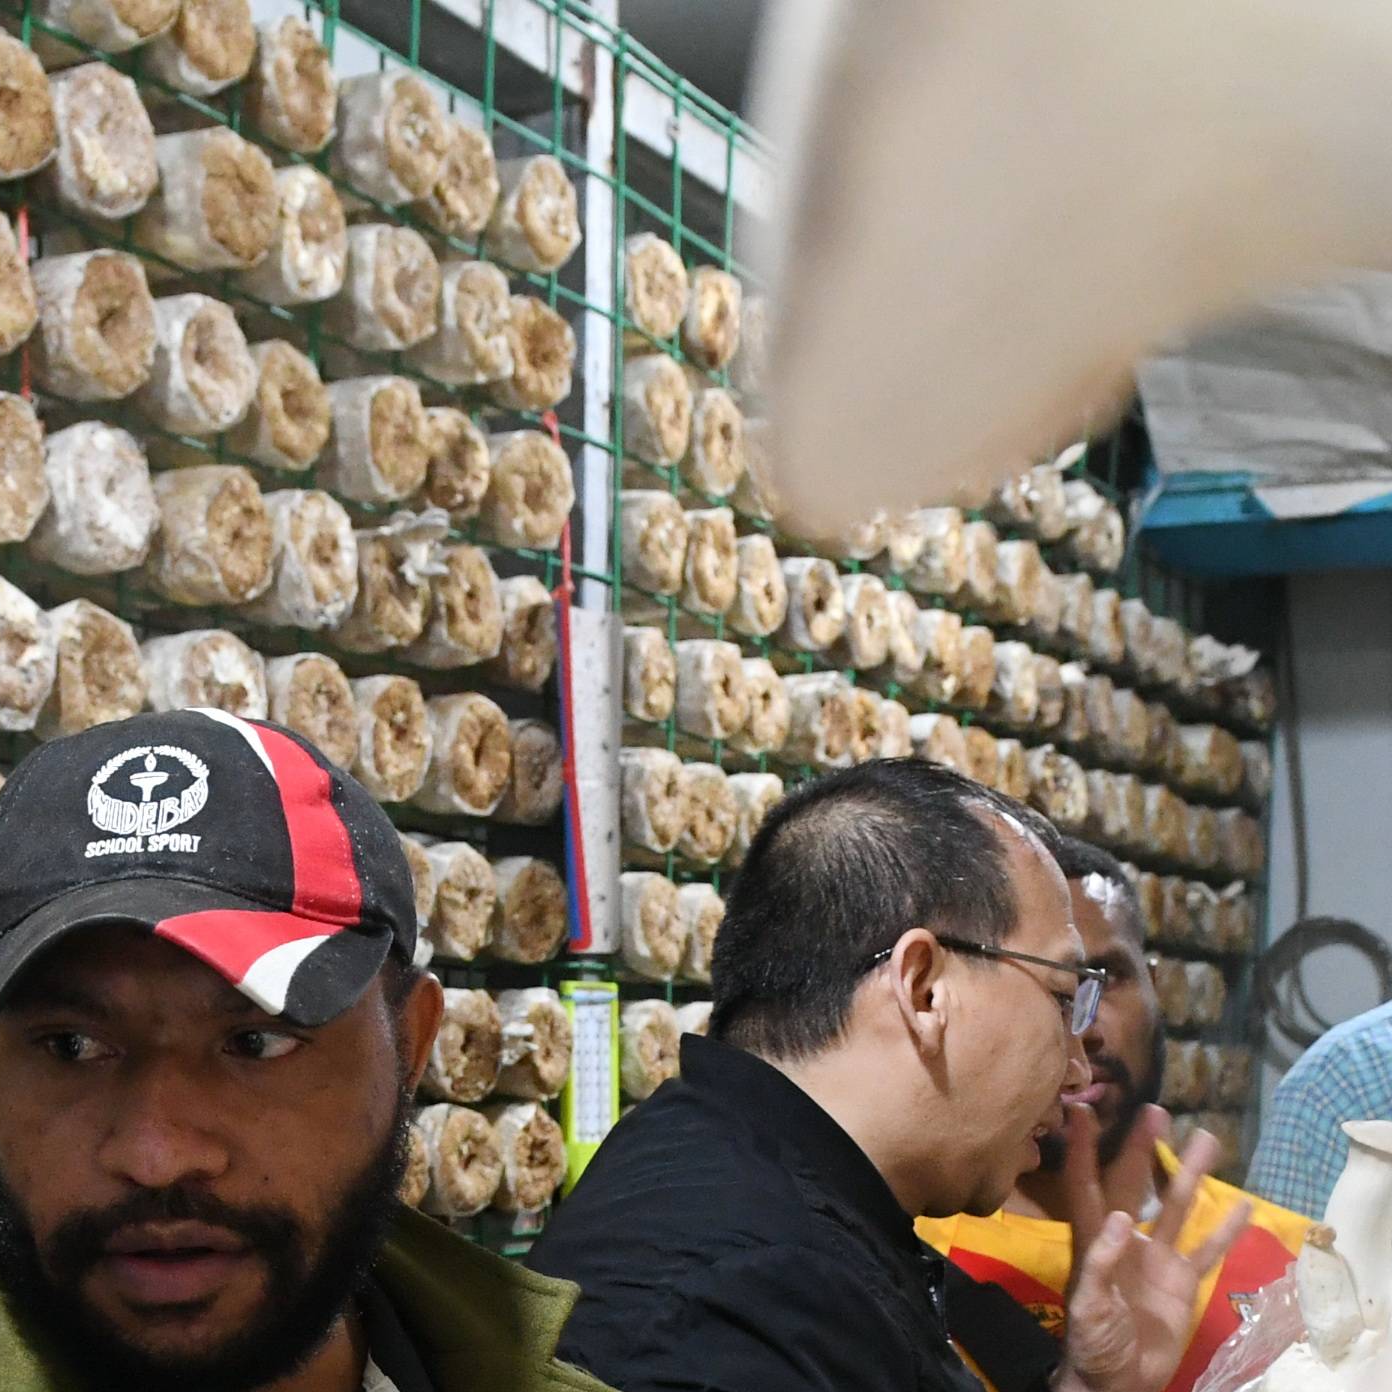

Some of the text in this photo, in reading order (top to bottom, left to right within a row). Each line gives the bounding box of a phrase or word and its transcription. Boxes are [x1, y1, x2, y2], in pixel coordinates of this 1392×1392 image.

[87, 777, 209, 836] WIDE BAY
[84, 833, 202, 858] SCHOOL SPORT
